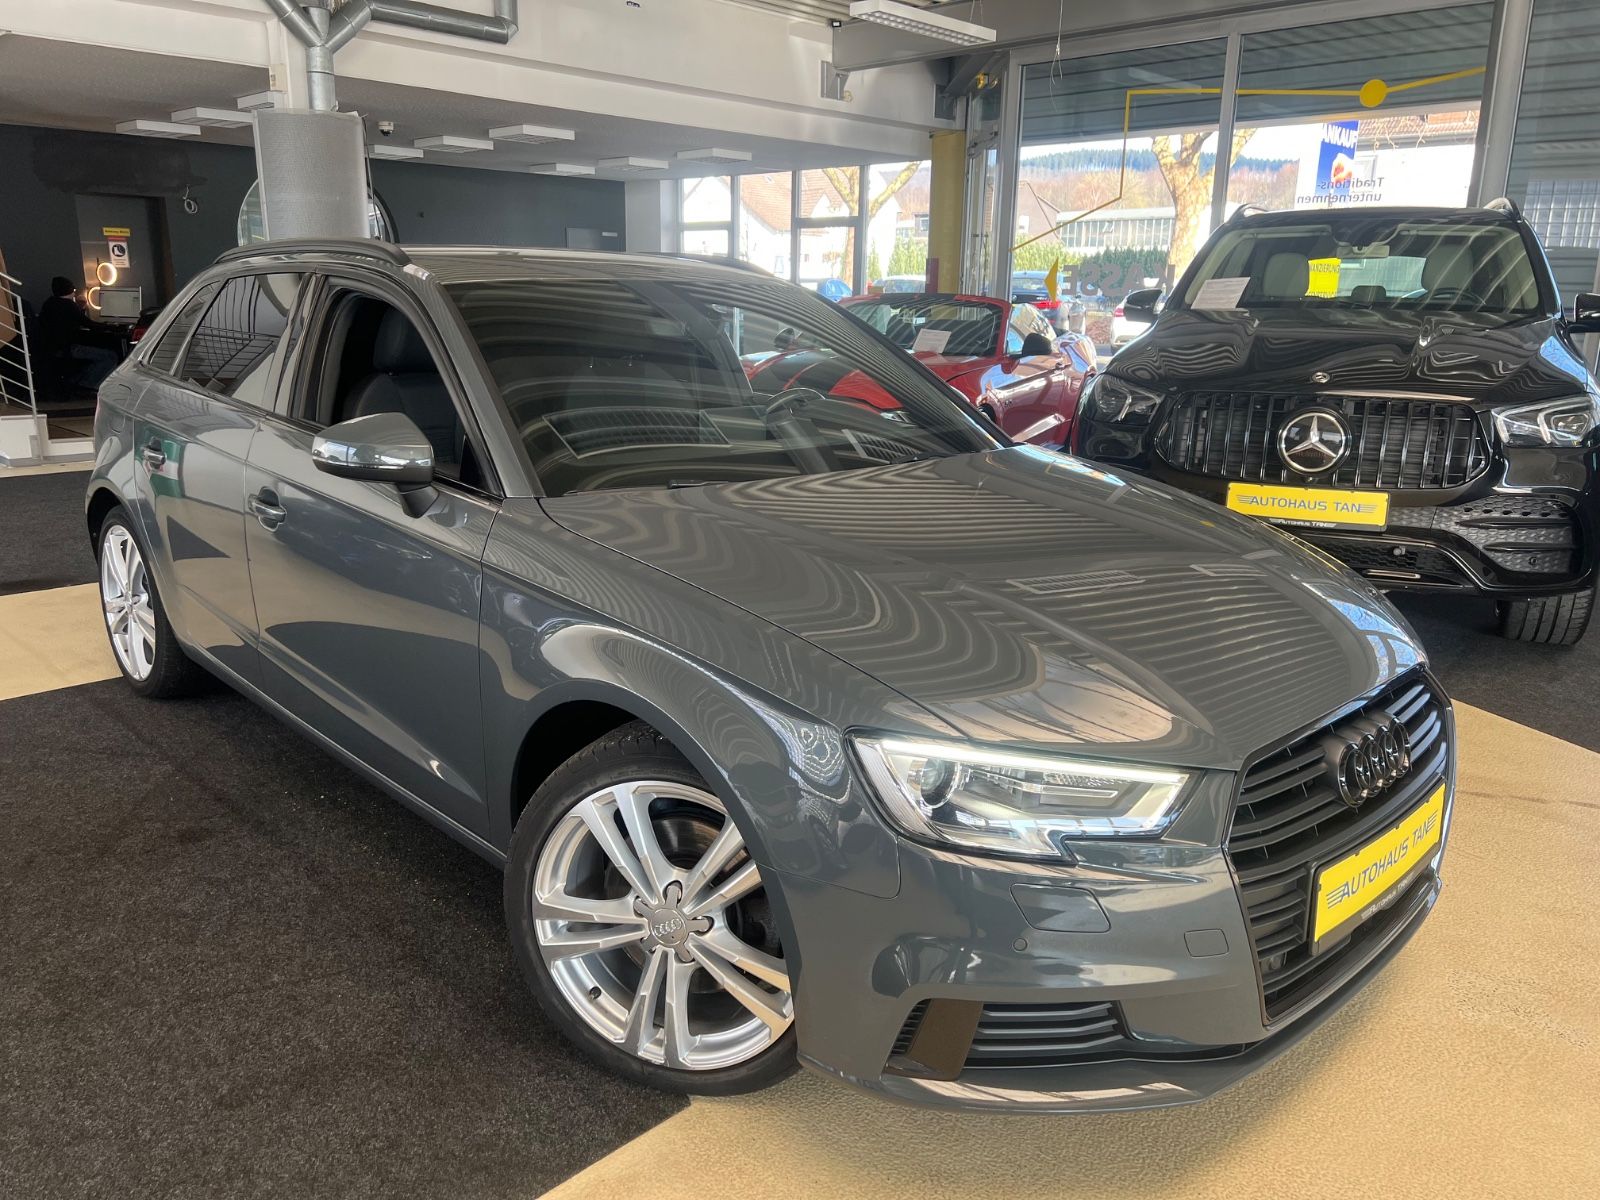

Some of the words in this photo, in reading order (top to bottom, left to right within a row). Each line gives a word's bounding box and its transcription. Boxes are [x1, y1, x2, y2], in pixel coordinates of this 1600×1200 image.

[1250, 495, 1328, 511] AUTOHAUS
[1334, 501, 1361, 513] TAN
[1340, 837, 1410, 903] AUTOHAUS
[1412, 820, 1430, 846] TAN
